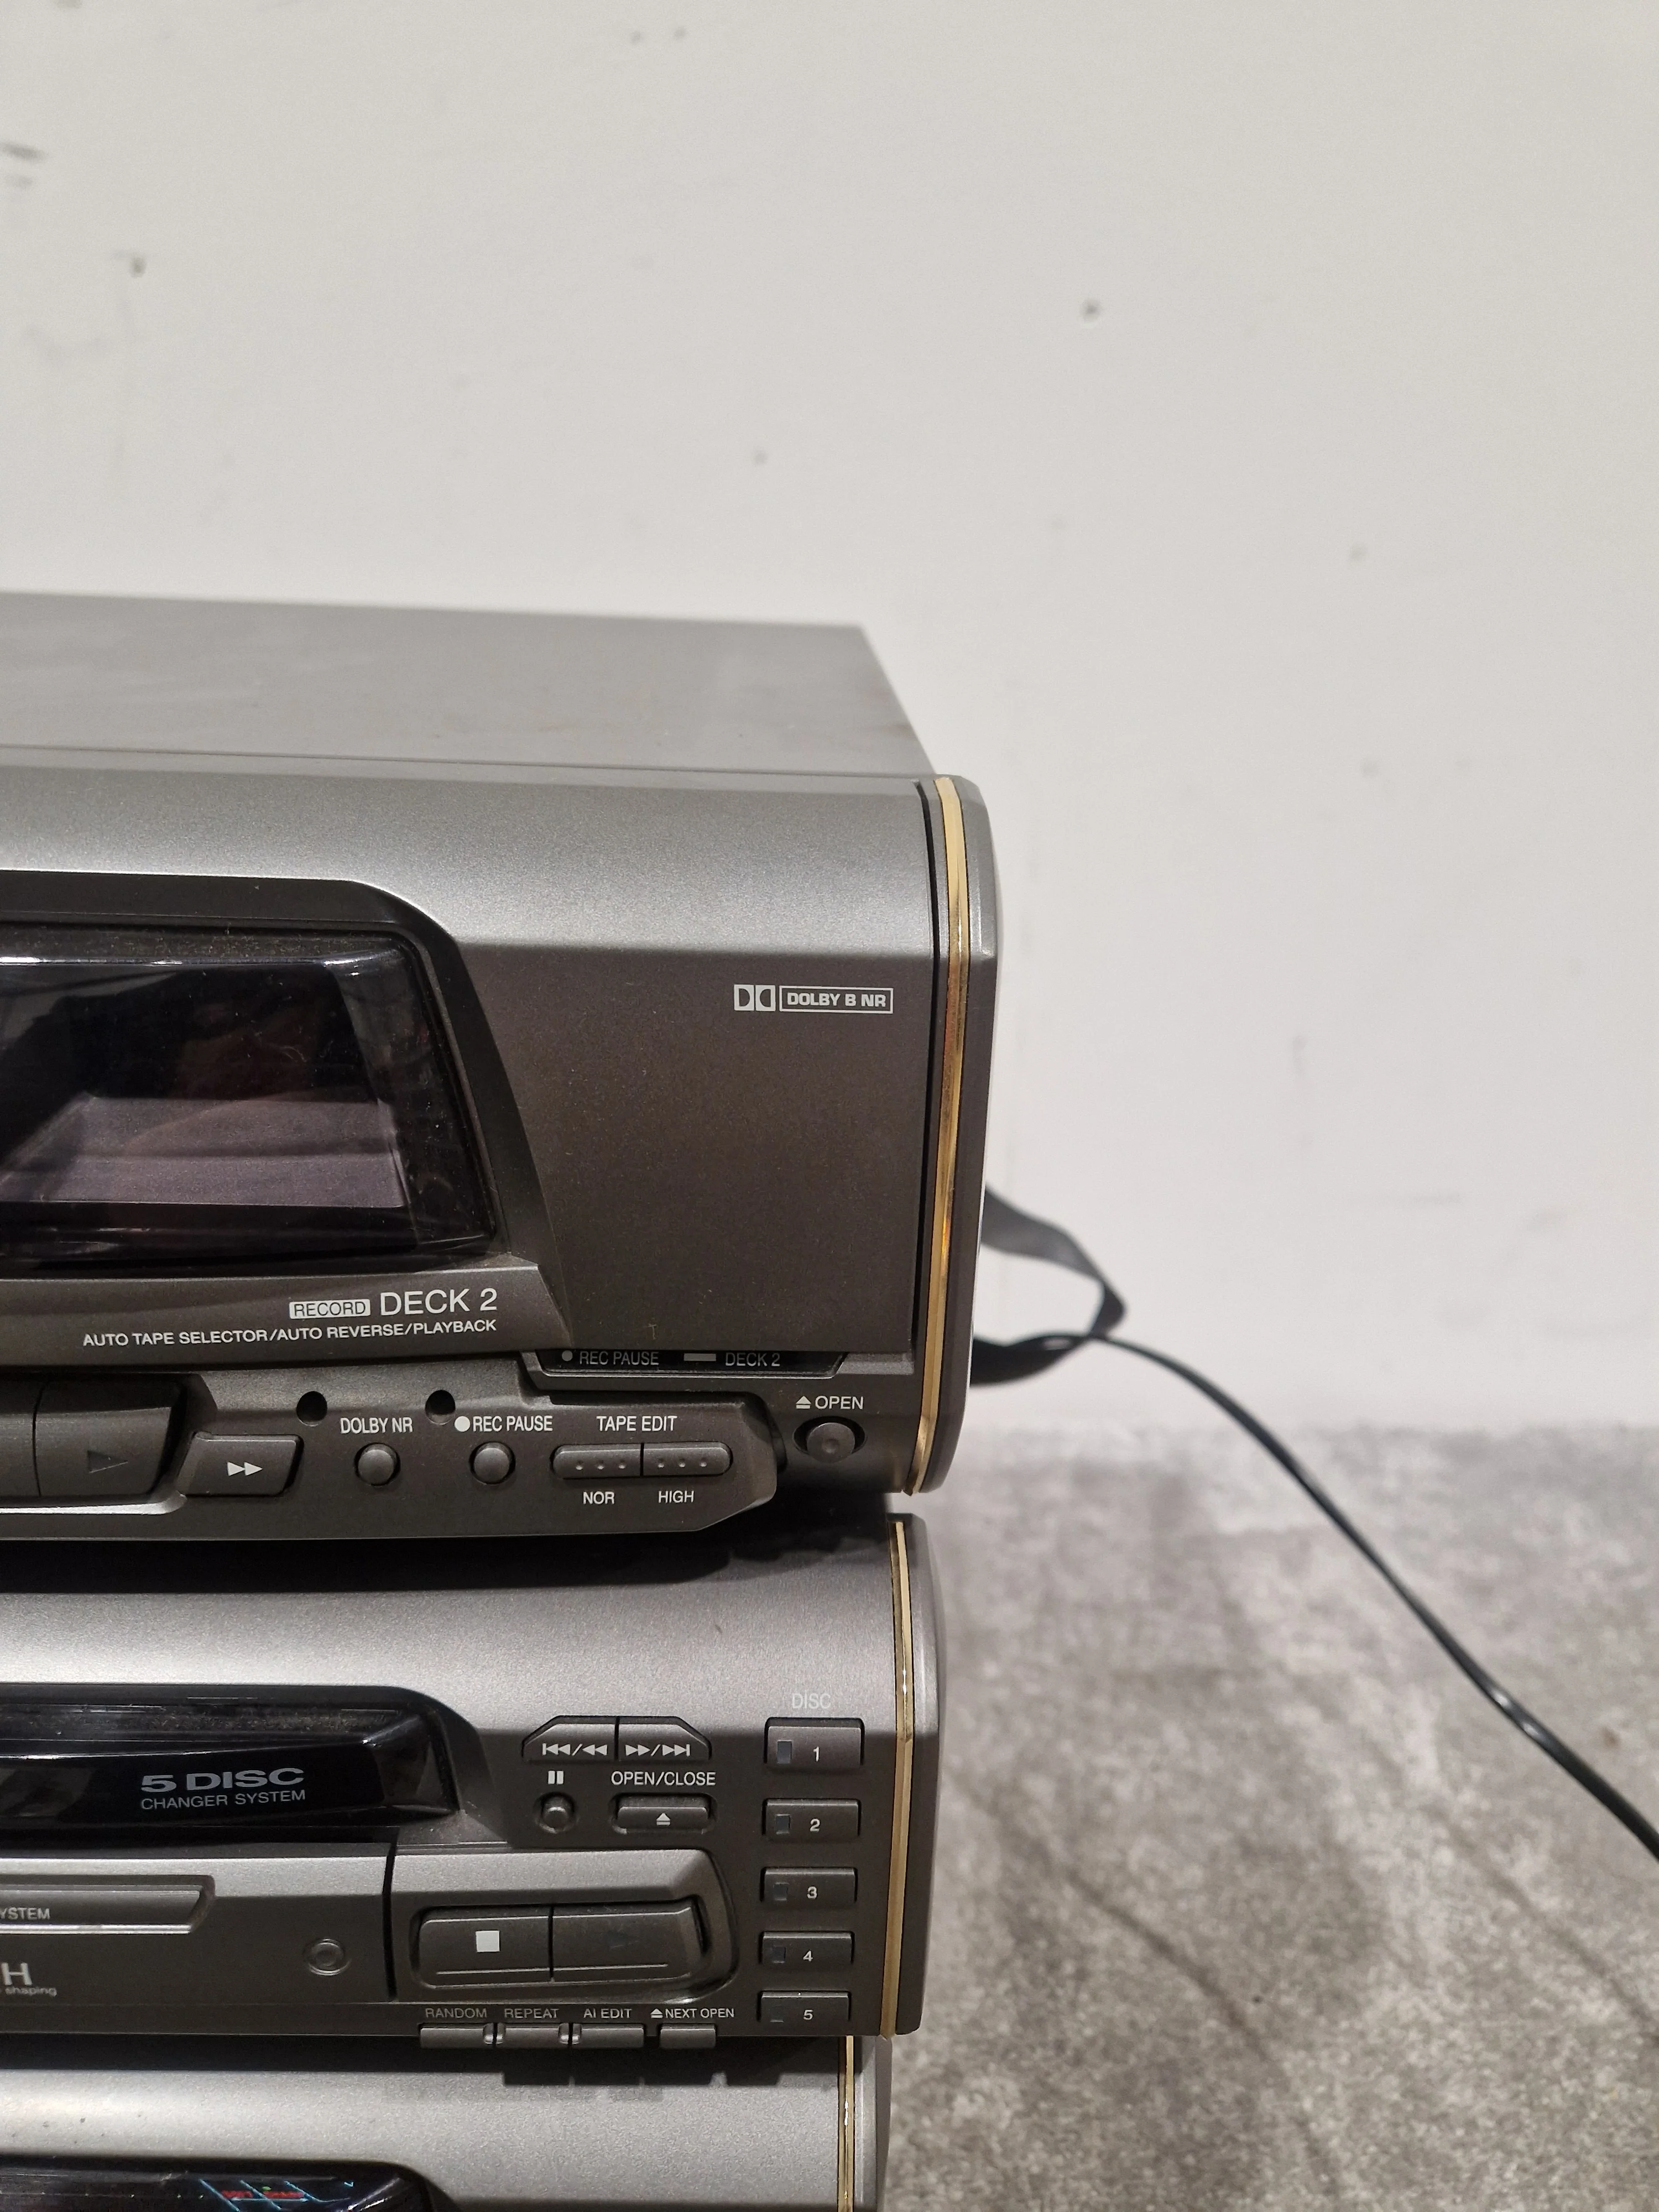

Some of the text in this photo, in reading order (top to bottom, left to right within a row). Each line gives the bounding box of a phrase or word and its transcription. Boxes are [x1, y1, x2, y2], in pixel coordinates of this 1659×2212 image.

[787, 992, 886, 1008] DOLBY B NR
[294, 1288, 498, 1317] RECORD DECK 2
[83, 1318, 497, 1346] AUTO TAPE SELECTOR/AUTO REVERSE/PLAYBACK
[580, 1351, 781, 1367] REC PAUSE DECK 2
[815, 1396, 864, 1410] OPEN
[340, 1417, 414, 1434] DOLBY NR
[472, 1415, 553, 1432] REC PAUSE
[596, 1415, 677, 1432] TAPE EDIT
[582, 1491, 615, 1505] NOR
[658, 1490, 695, 1504] HIGH
[791, 1693, 832, 1709] DISC
[813, 1747, 821, 1761] 1
[140, 1767, 305, 1793] 5 DISC
[611, 1771, 717, 1786] OPEN/CLOSE
[141, 1789, 306, 1811] CHANGER SYSTEM
[810, 1819, 821, 1833] 2
[806, 1886, 818, 1900] 3
[802, 1950, 814, 1962] 4
[425, 2008, 487, 2018] RANDOM
[504, 2008, 560, 2018] REPEAT
[601, 2008, 633, 2018] EDIT
[665, 2008, 735, 2018] NEXT OPEN
[803, 2009, 814, 2020] 5
